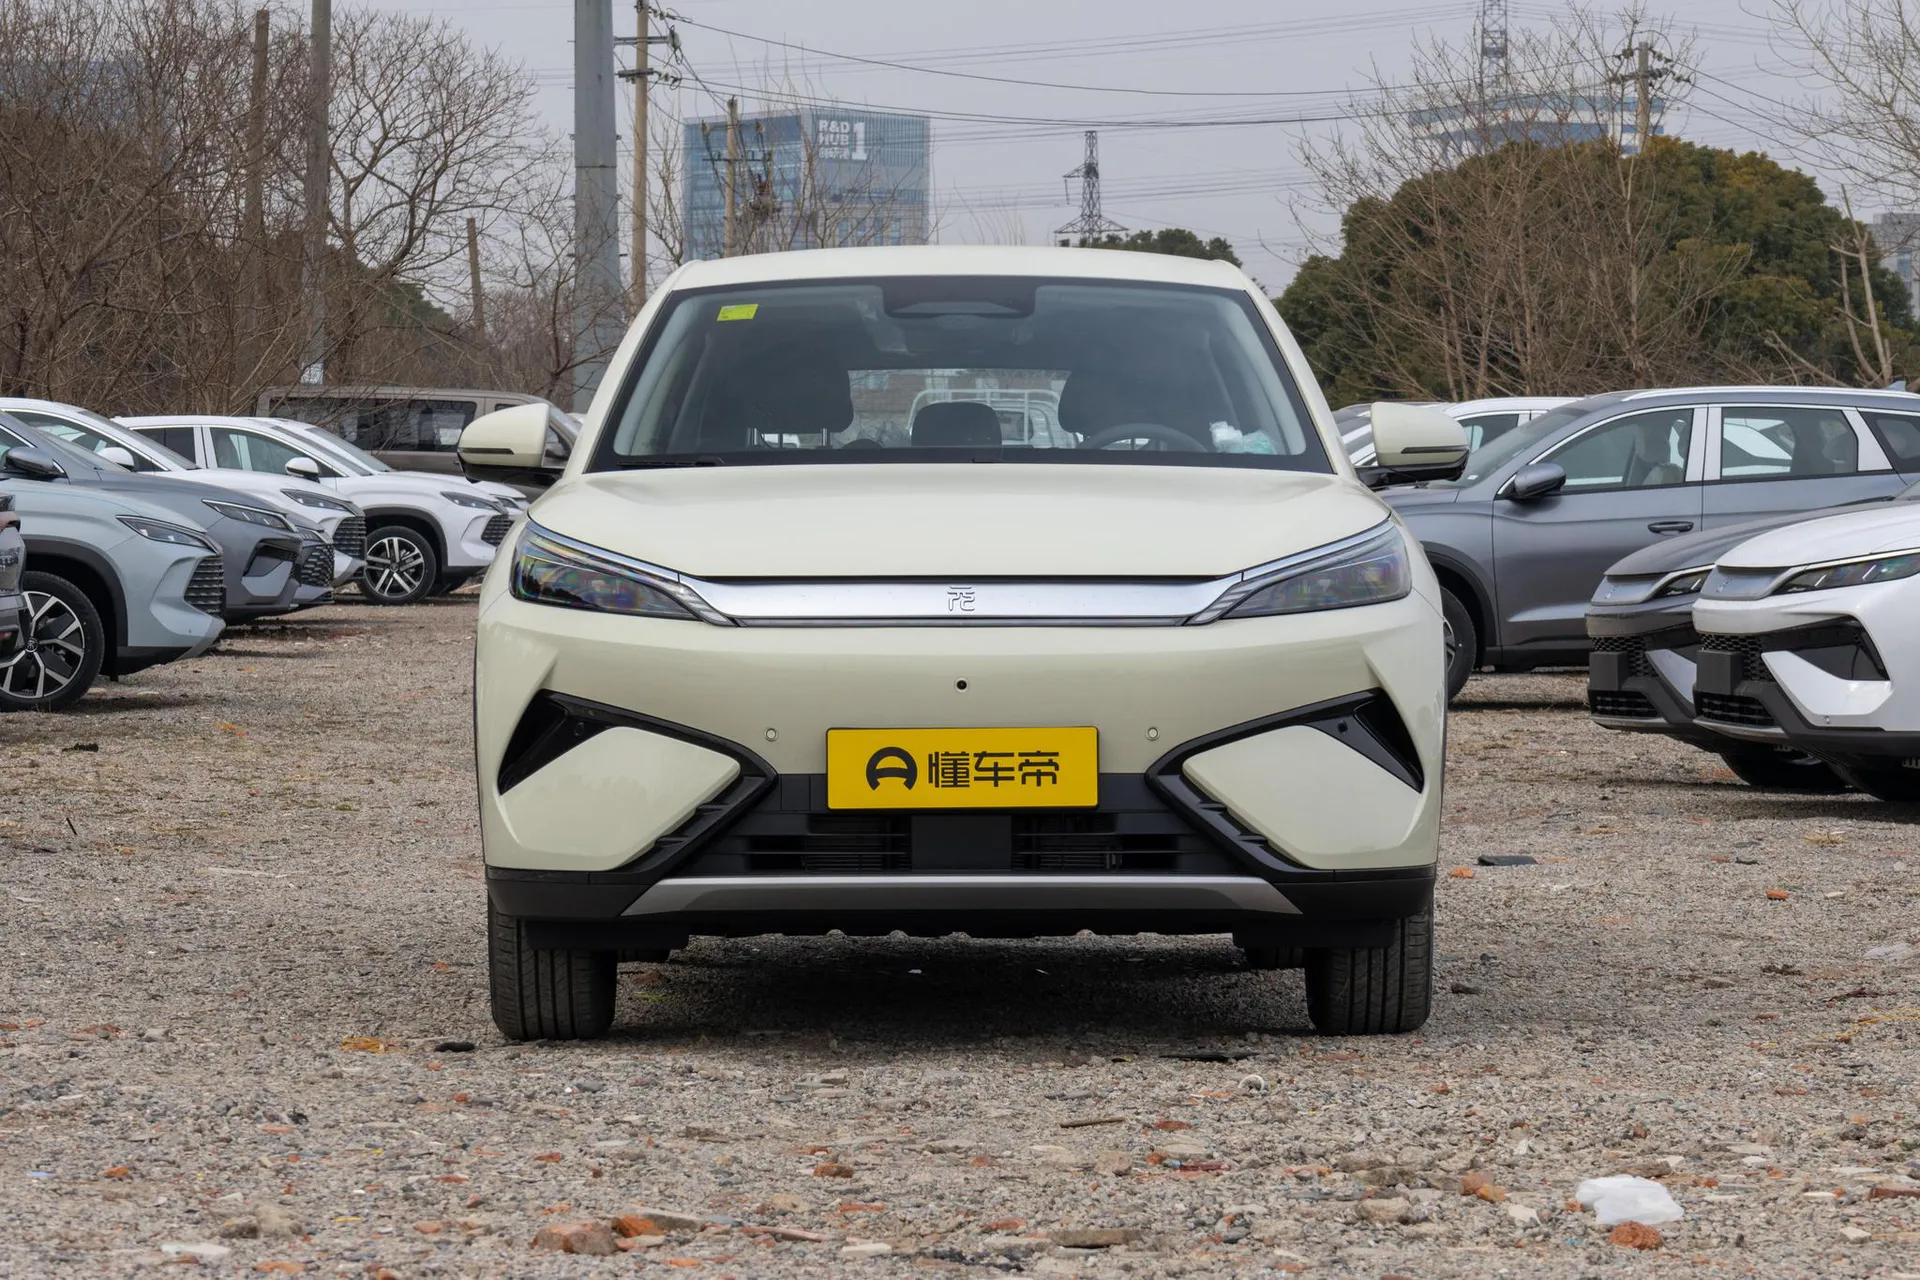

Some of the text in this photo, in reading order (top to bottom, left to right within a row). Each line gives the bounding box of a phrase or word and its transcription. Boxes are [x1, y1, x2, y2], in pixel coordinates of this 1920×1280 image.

[819, 120, 850, 133] R&D
[819, 133, 849, 145] HUB
[852, 122, 867, 160] 1
[928, 750, 1060, 788] 懂车帝
